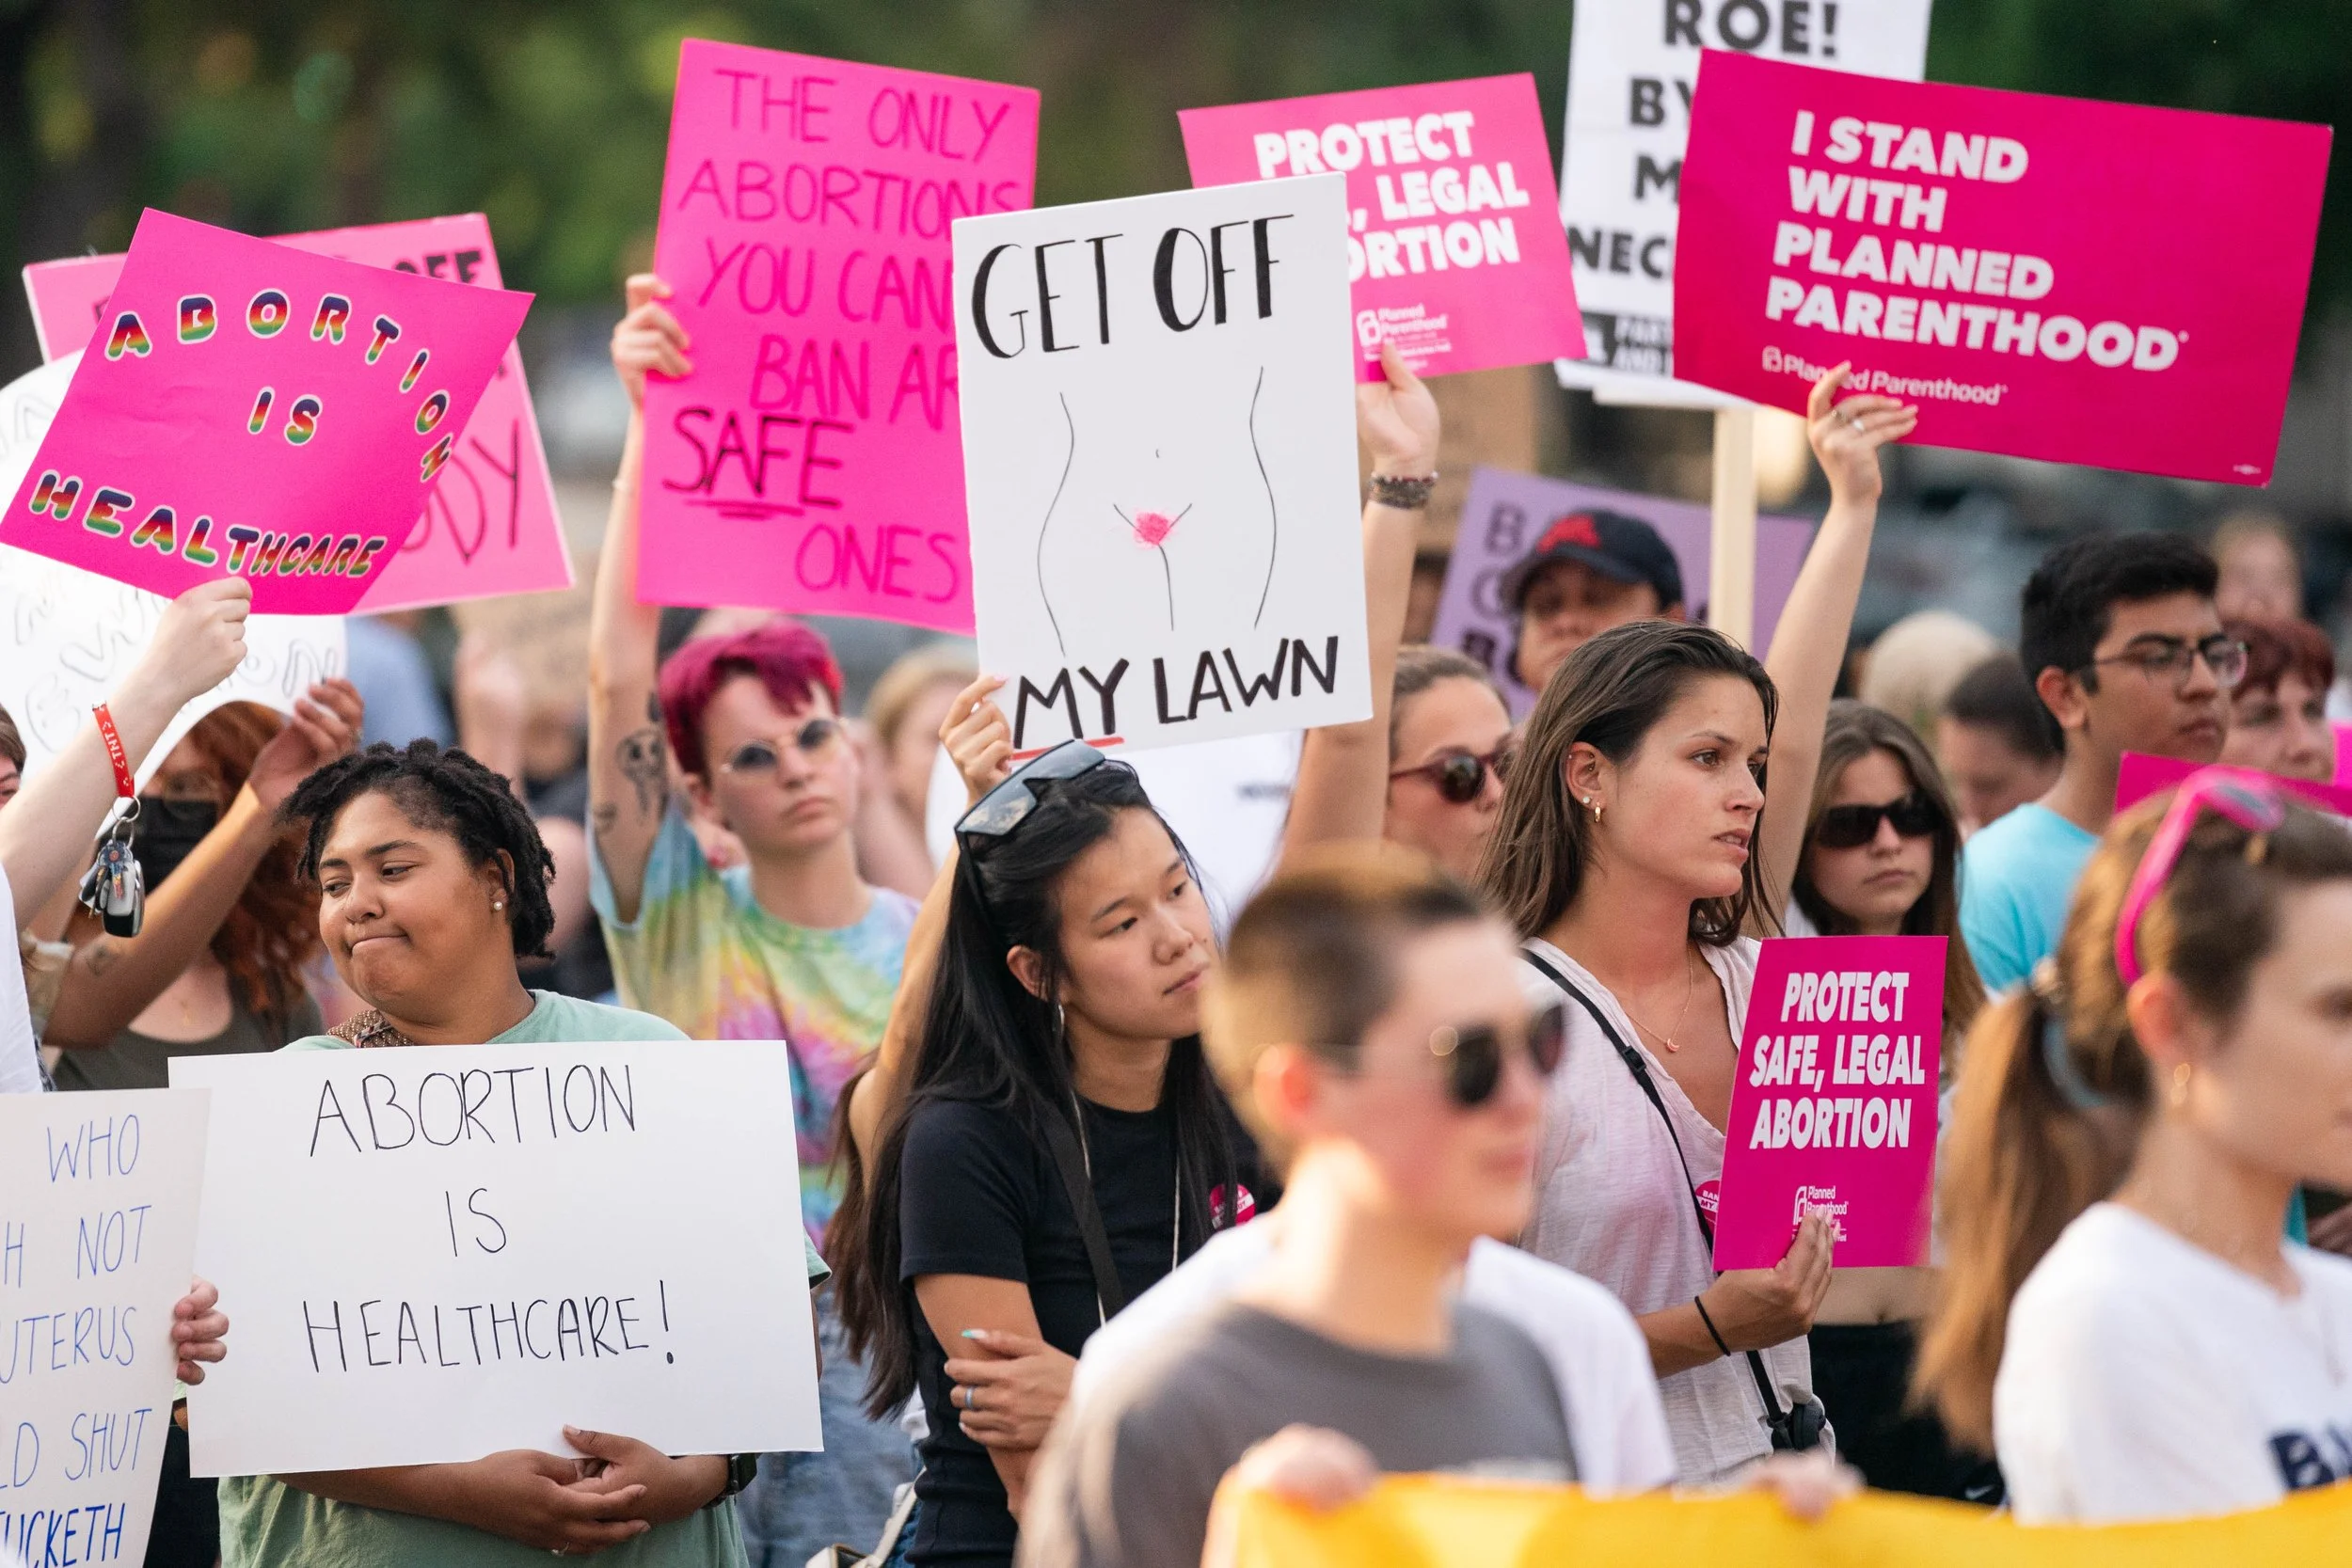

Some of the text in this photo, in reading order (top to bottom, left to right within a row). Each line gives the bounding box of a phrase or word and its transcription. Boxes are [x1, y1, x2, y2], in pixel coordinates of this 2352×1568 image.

[1663, 0, 1838, 57] ROE!
[714, 68, 1011, 165] THE ONLY
[1253, 110, 1474, 179] PROTECT
[1791, 109, 2028, 183] I STAND
[1376, 162, 1530, 222] LEGAL
[1788, 166, 1947, 233] WITH
[697, 236, 953, 333] YOU CAN
[971, 214, 1295, 359] GET OFF
[1773, 220, 2054, 301] PLANNED
[1765, 276, 2178, 372] PARENTHOOD
[107, 289, 450, 482] ABORTION
[750, 333, 869, 420] BAN
[1871, 370, 2001, 406] Parenthood
[247, 387, 322, 446] IS
[663, 406, 854, 509] SAFE
[29, 470, 387, 578] HEALTHCARE
[794, 522, 961, 603] ONES
[1013, 636, 1339, 751] MY LAWN
[1781, 971, 1909, 1022] PROTECT
[1749, 1035, 1926, 1093] SAFE, LEGAL
[310, 1064, 636, 1157] ABORTION
[1749, 1097, 1912, 1149] ABORTION
[46, 1114, 140, 1183] WHO
[445, 1188, 507, 1257] IS
[1807, 1185, 1836, 1199] Planned
[76, 1205, 152, 1280] NOT
[303, 1279, 675, 1373] HEALTHCARE!
[65, 1408, 152, 1481] SHUT
